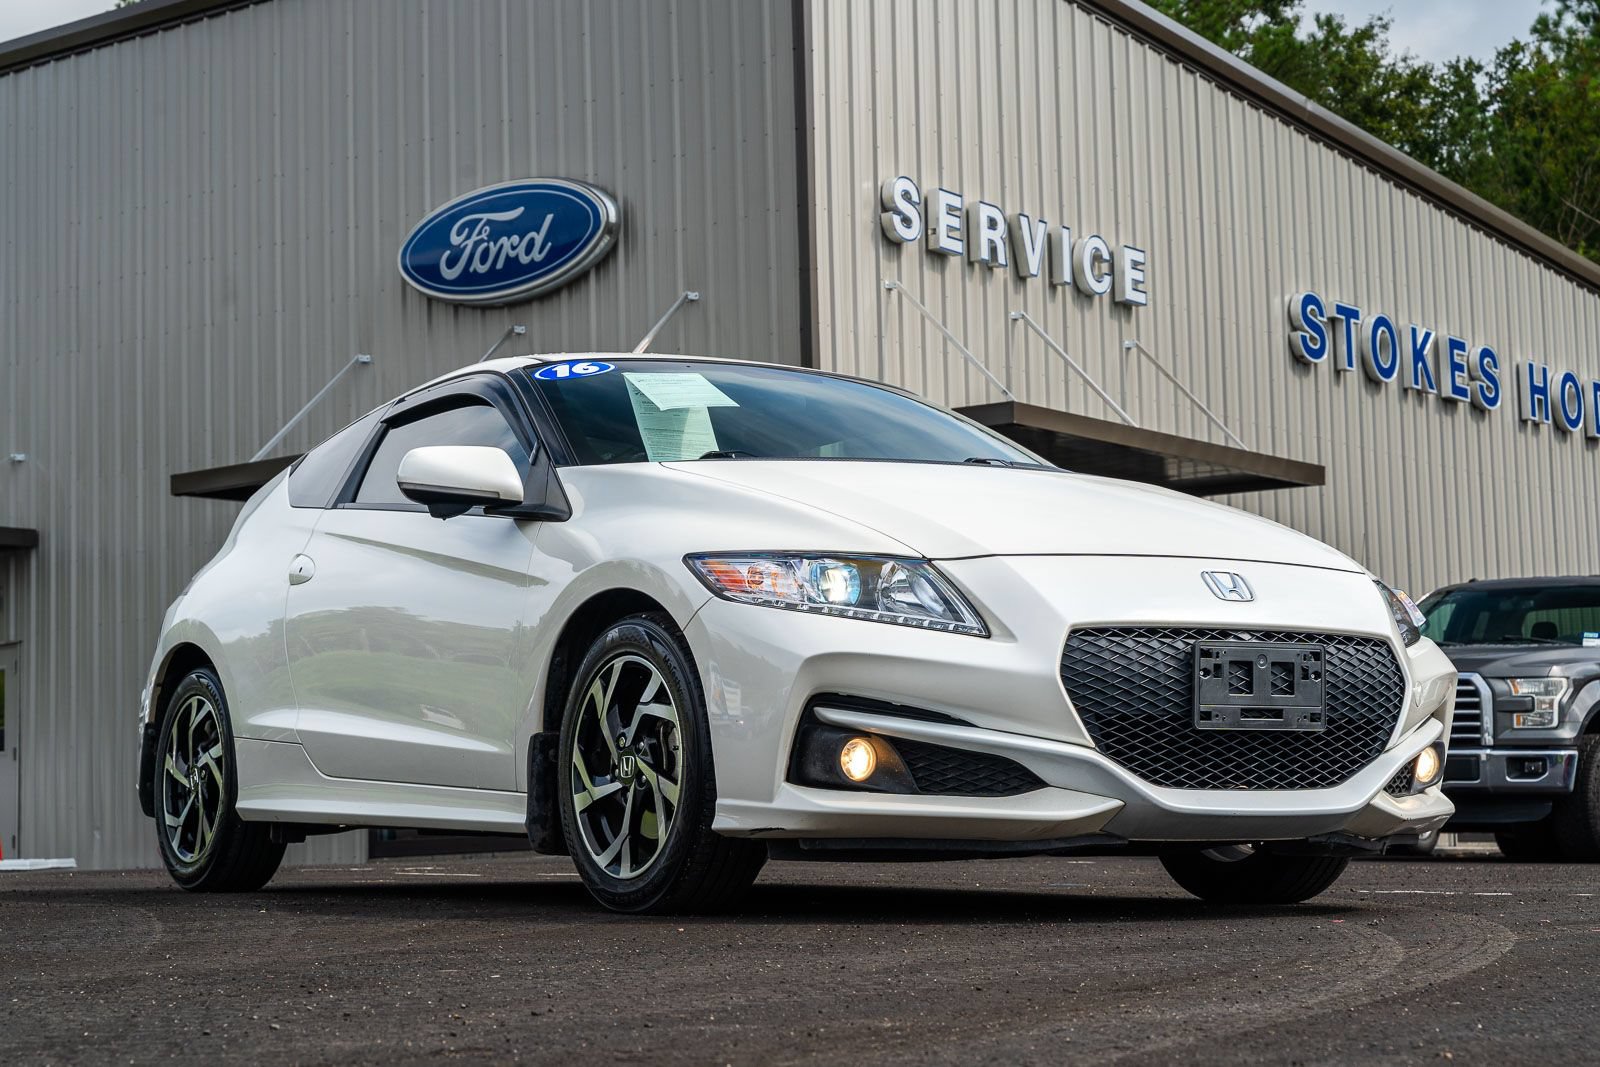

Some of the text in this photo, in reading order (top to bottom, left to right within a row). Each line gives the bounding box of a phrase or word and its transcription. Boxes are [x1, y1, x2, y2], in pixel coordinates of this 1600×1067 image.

[439, 205, 555, 281] Ford
[882, 176, 1147, 306] SERVICE
[551, 362, 601, 378] 16
[1291, 291, 1502, 411] STOKES
